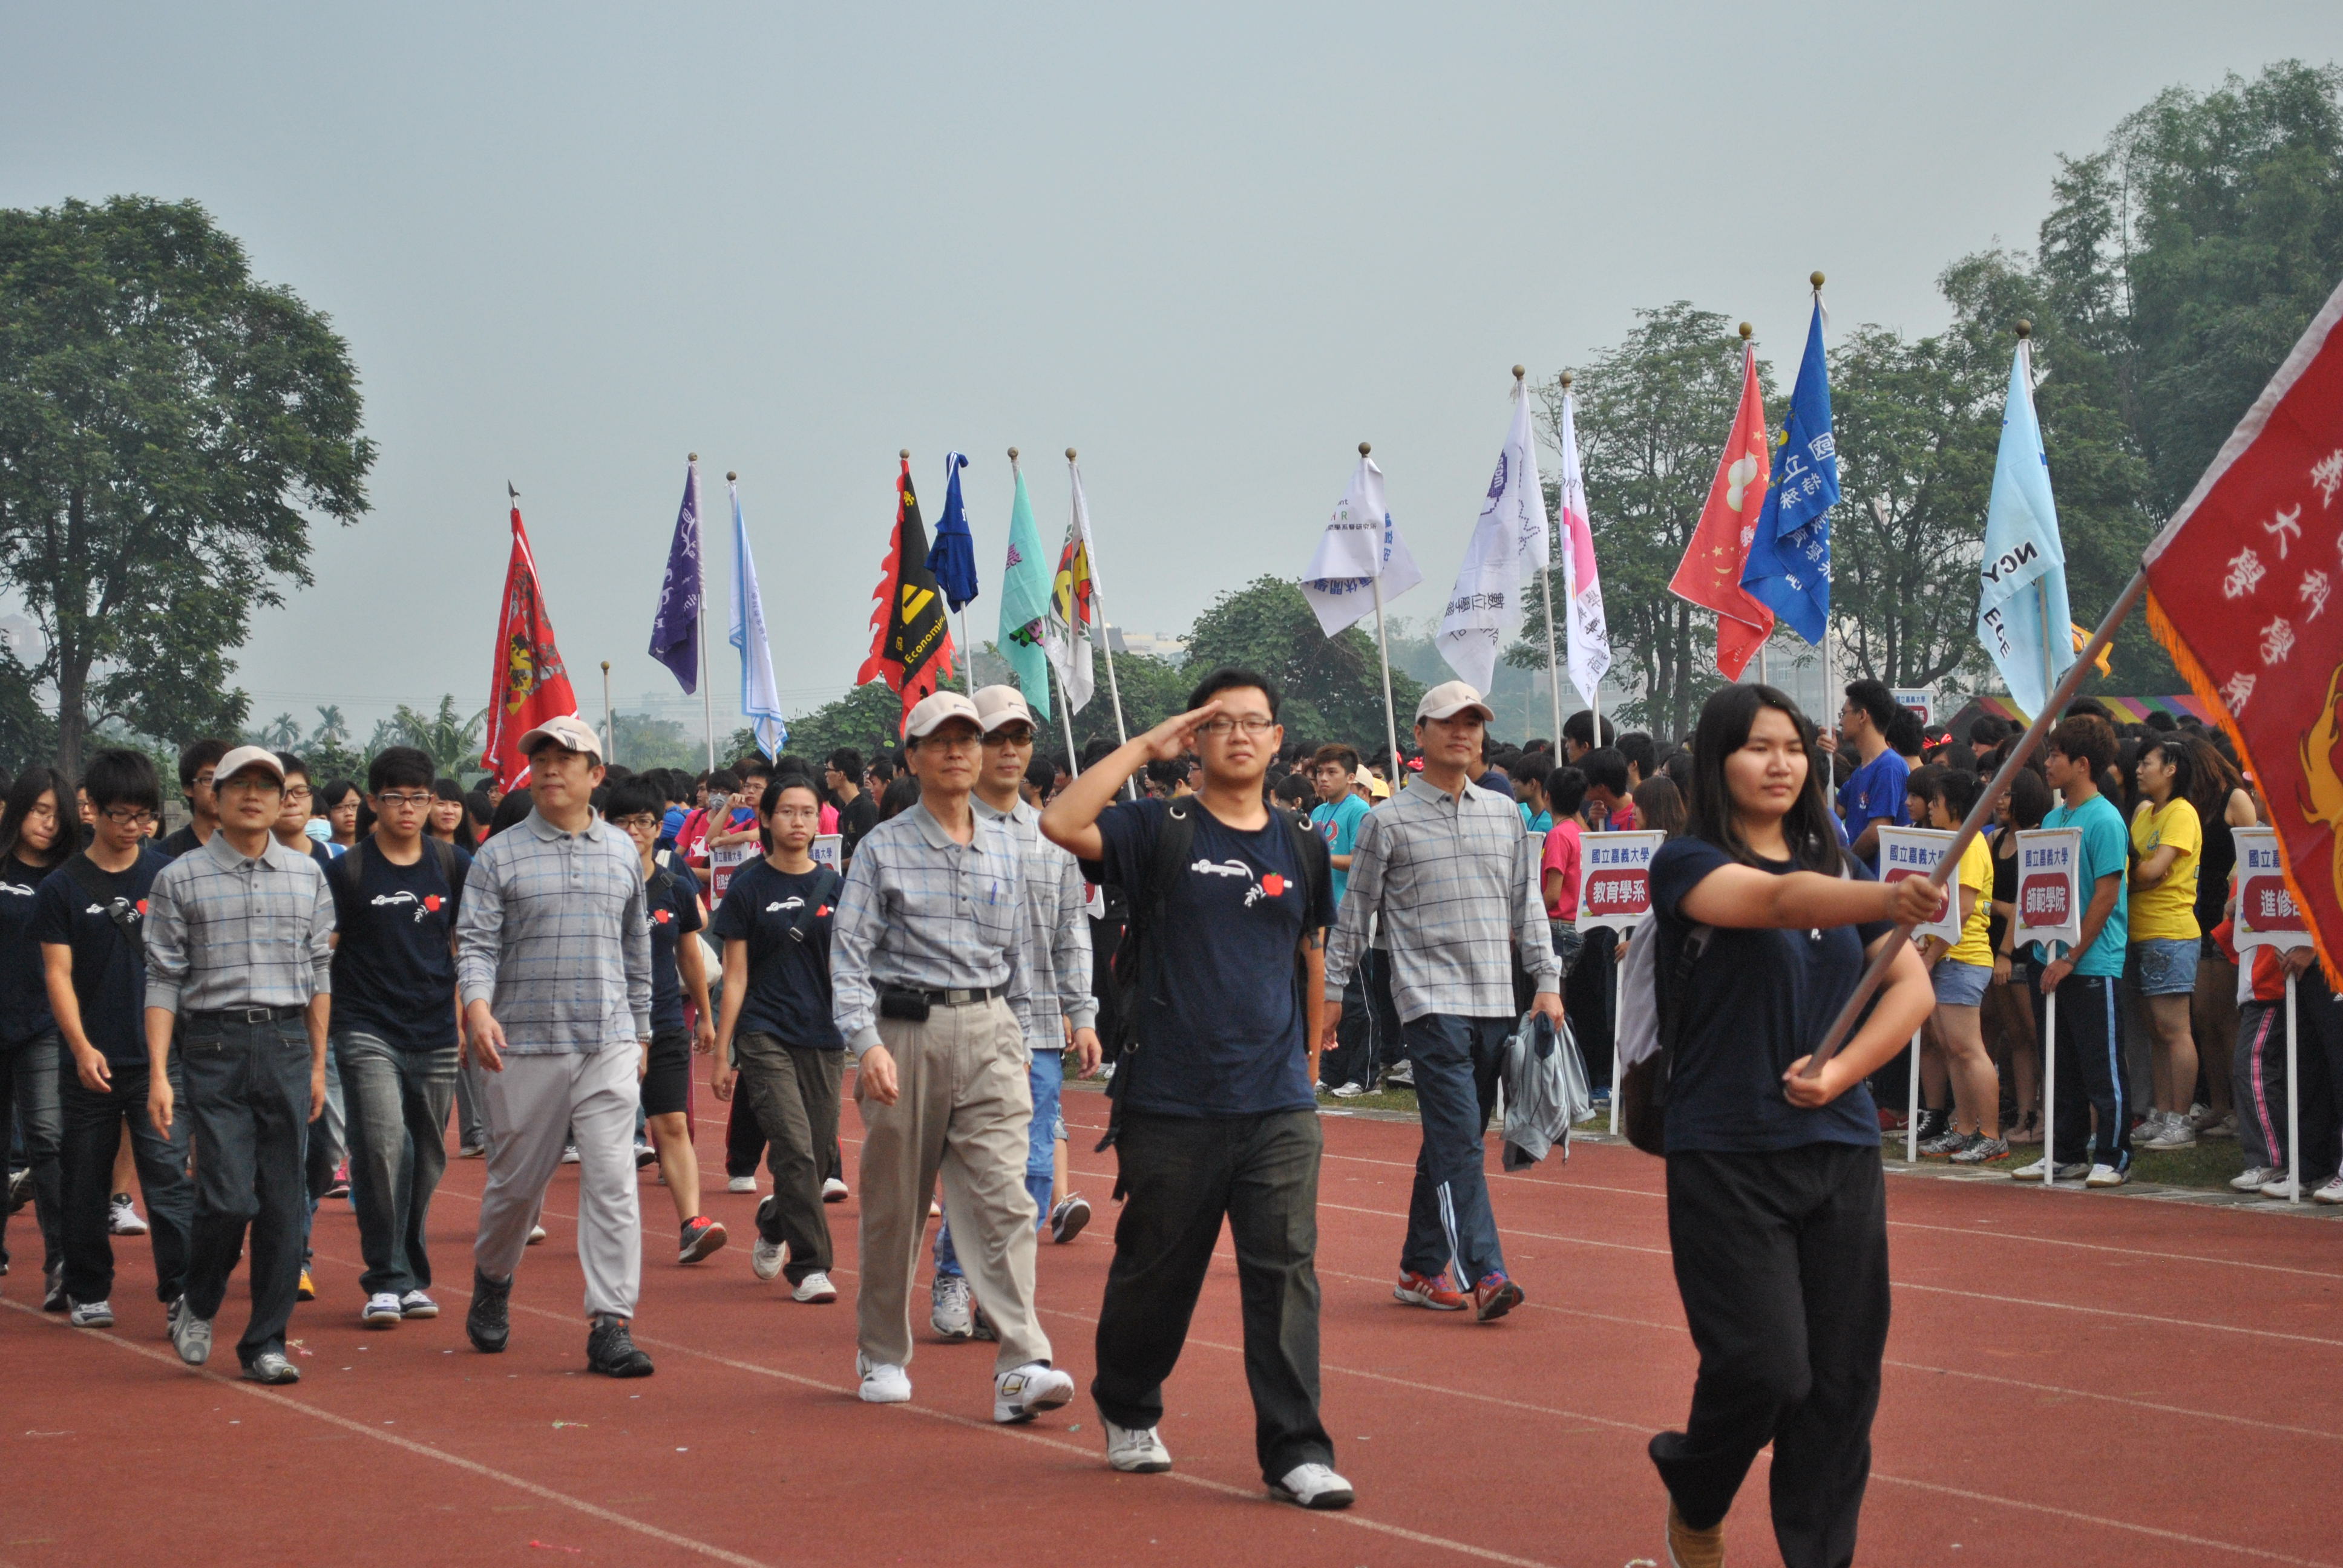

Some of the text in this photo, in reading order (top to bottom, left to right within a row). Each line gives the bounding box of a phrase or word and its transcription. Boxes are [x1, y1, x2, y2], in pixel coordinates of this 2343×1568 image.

[1591, 847, 1650, 864] 國立嘉義大學
[2025, 847, 2068, 867] 國立嘉義大學
[1593, 880, 1645, 904] 教育學系
[2026, 886, 2066, 913] 師範學院
